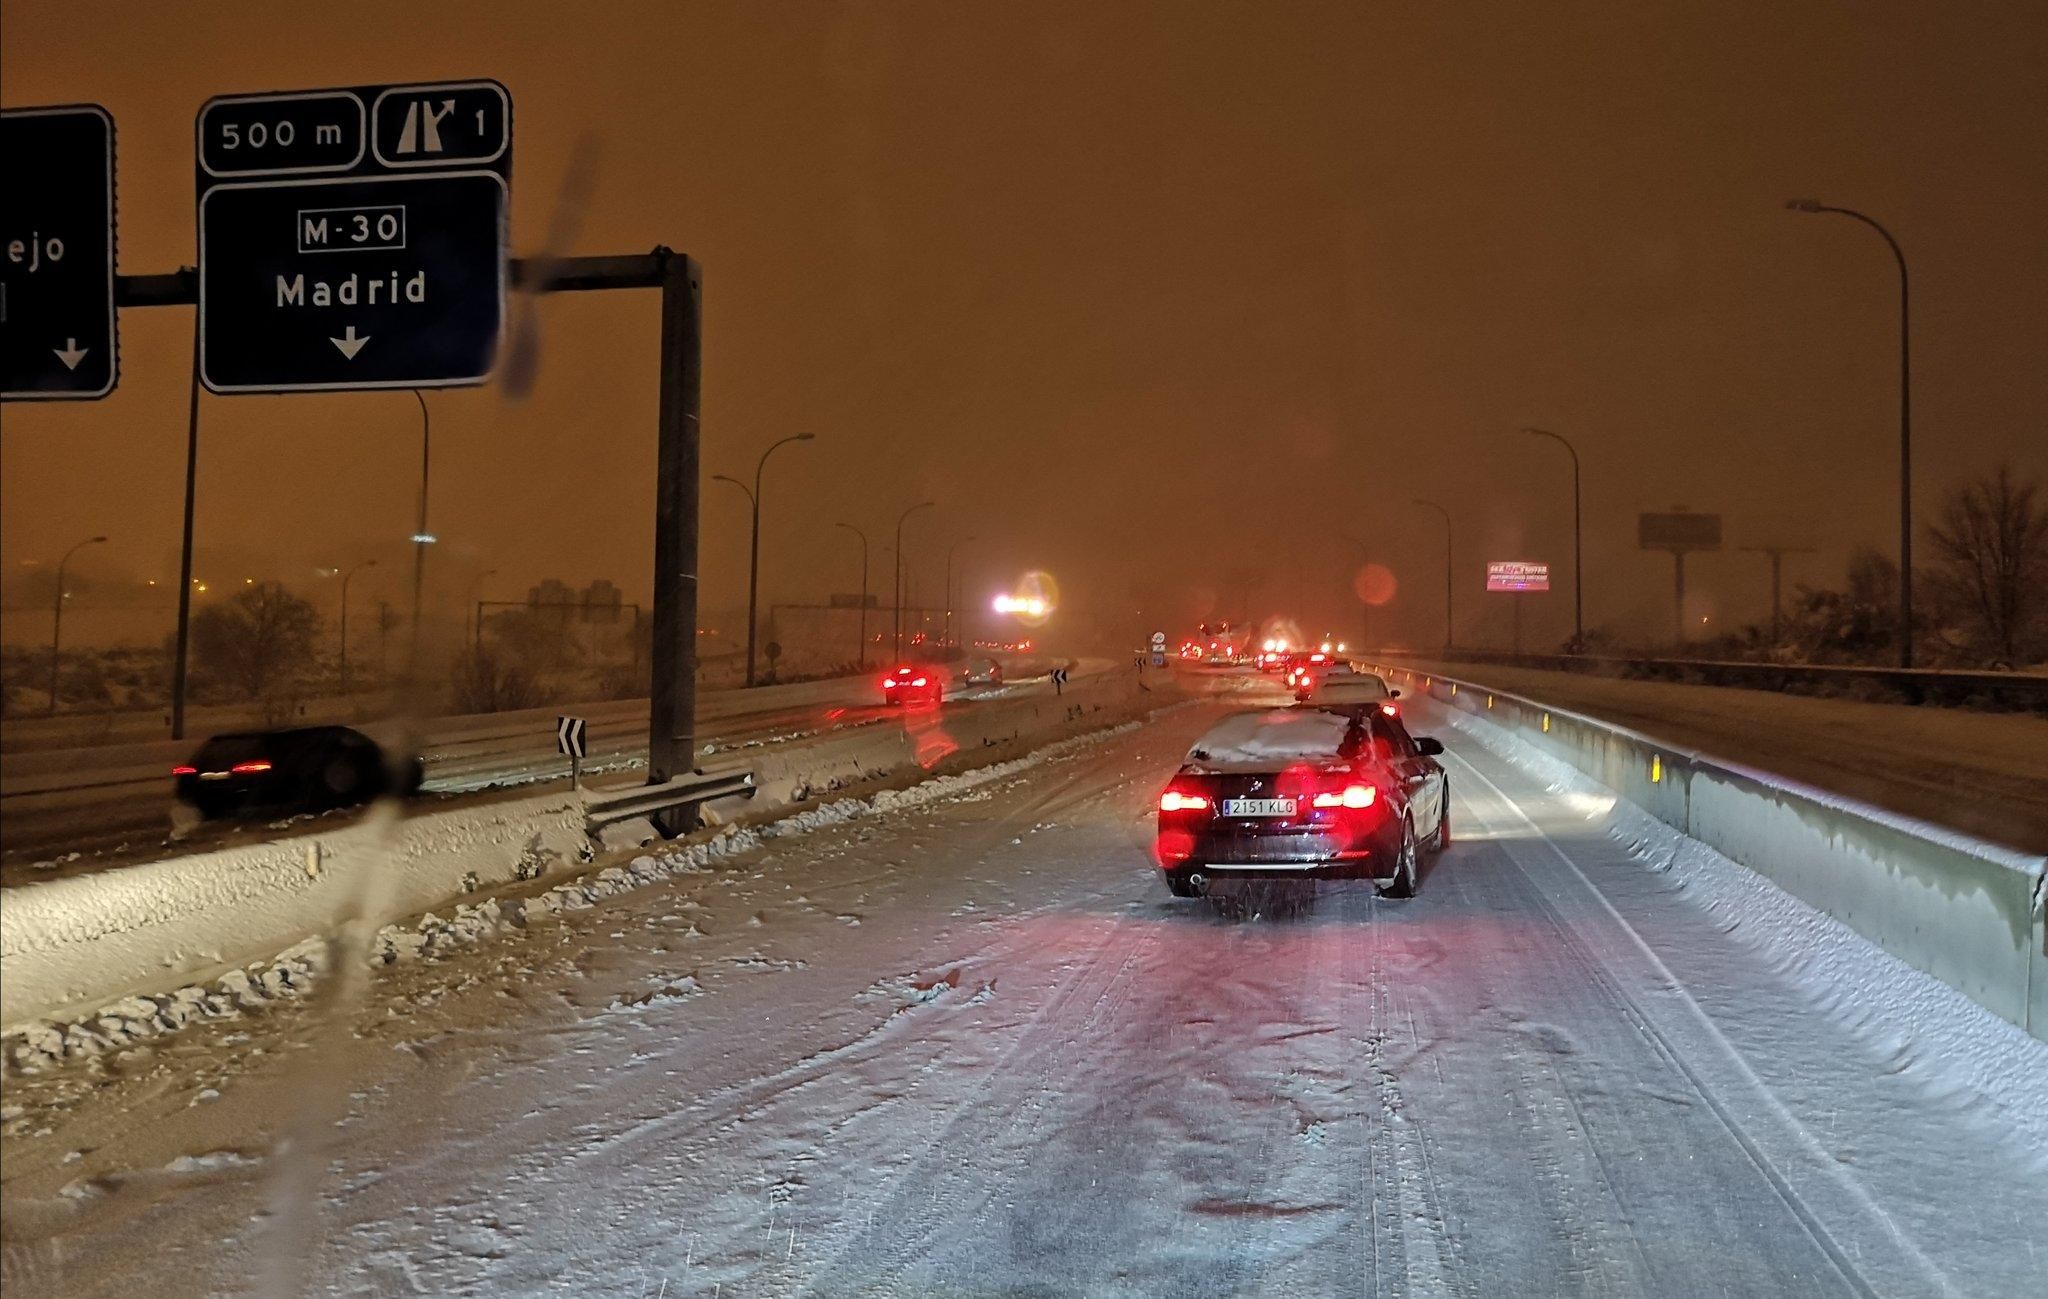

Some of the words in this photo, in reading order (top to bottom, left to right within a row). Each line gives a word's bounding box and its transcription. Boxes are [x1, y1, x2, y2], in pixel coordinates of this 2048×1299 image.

[222, 120, 295, 150] 500
[315, 124, 342, 145] m
[476, 109, 485, 137] 1
[304, 213, 398, 245] M-30
[276, 270, 426, 308] Madrid
[1233, 801, 1264, 814] 2151
[1269, 800, 1293, 813] KLG
